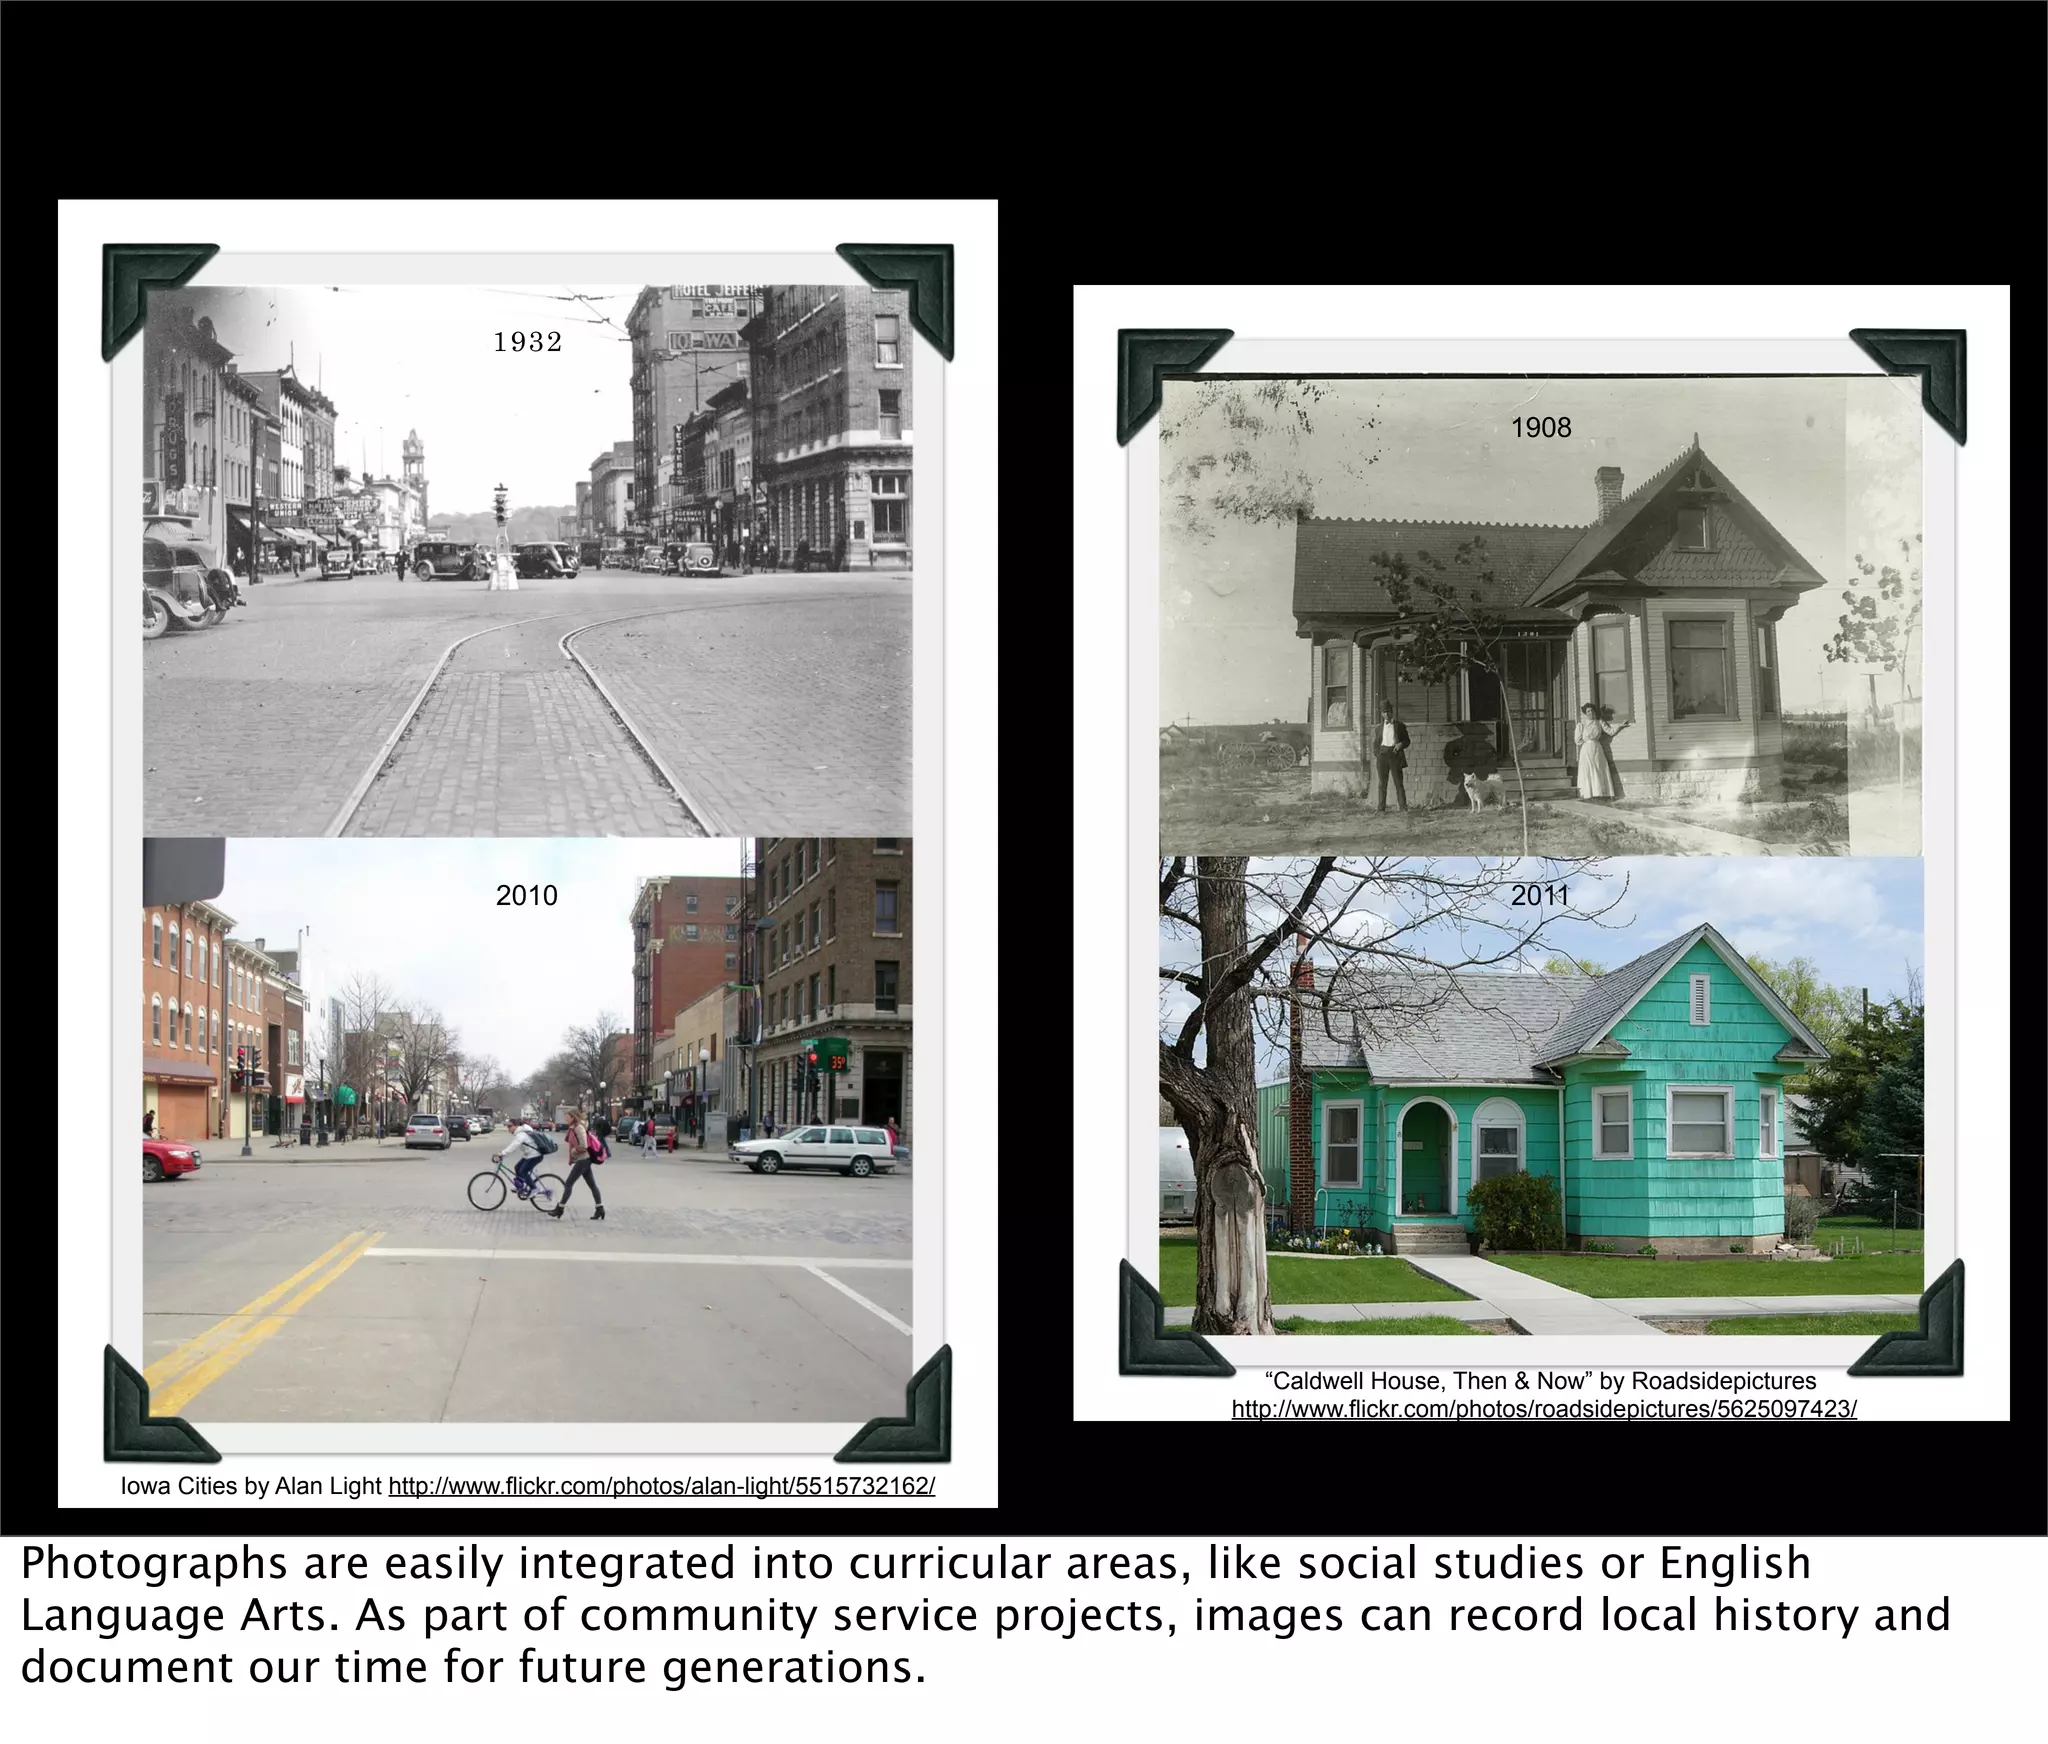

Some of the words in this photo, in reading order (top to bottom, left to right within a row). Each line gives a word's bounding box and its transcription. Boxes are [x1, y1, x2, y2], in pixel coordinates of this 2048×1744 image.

[675, 285, 710, 296] HOTEL
[705, 304, 735, 312] CAFE
[168, 401, 177, 476] DRUGS
